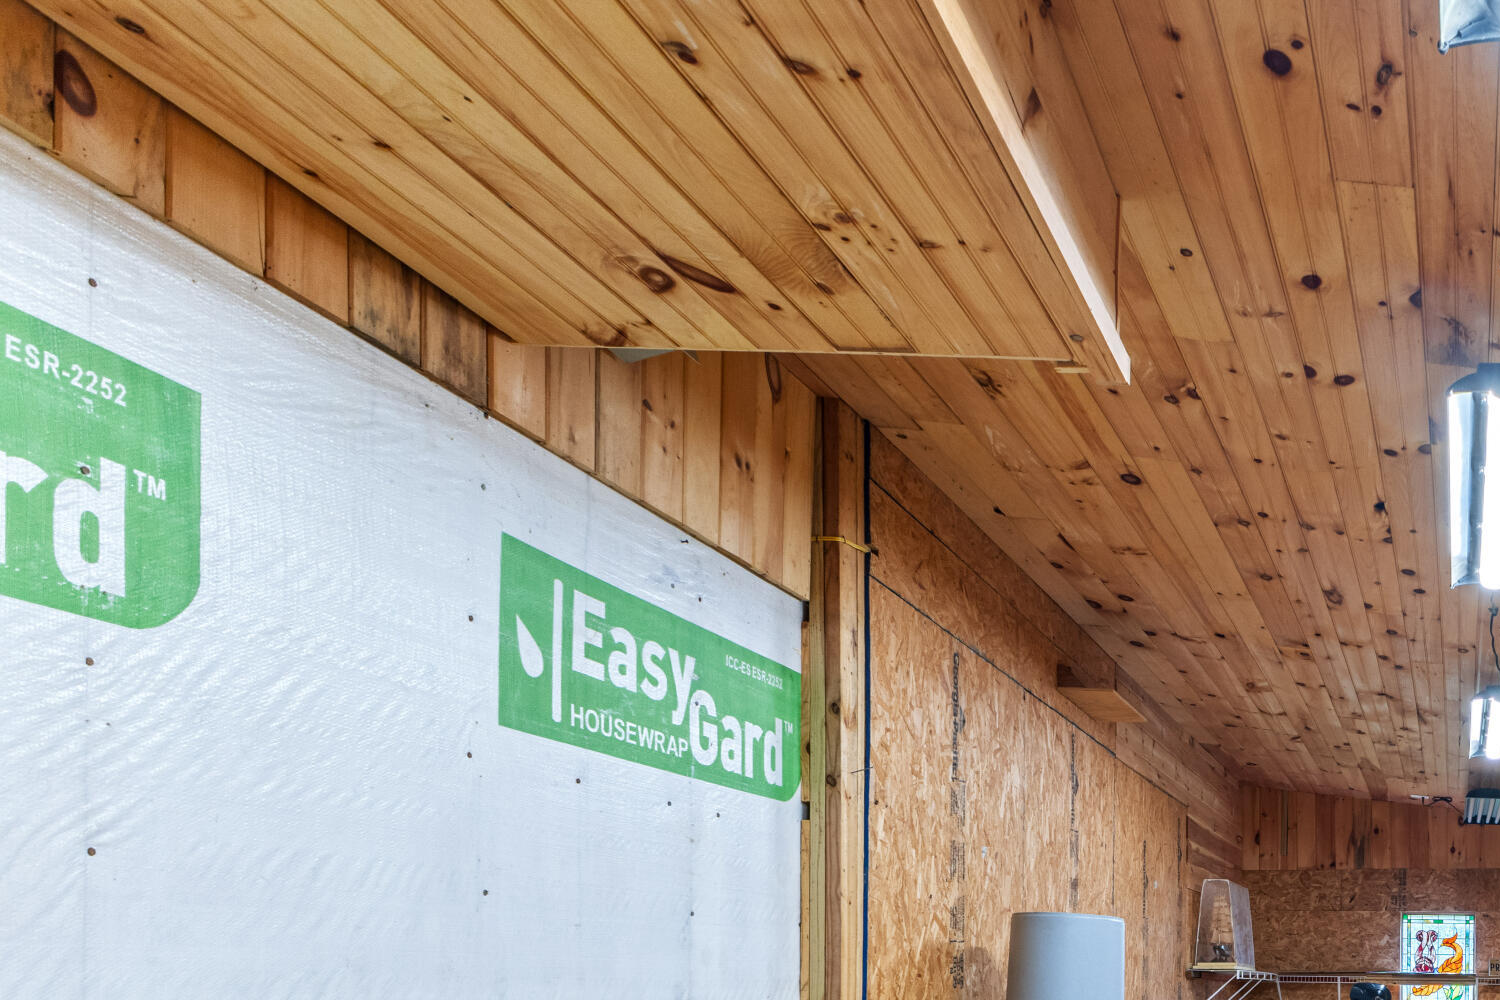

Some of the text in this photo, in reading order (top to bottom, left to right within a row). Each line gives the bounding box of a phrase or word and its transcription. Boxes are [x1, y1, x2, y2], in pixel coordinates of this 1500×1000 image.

[4, 333, 128, 407] ESR-2252
[726, 653, 752, 676] ICC-ES
[570, 703, 689, 759] HOUSEWRAP
